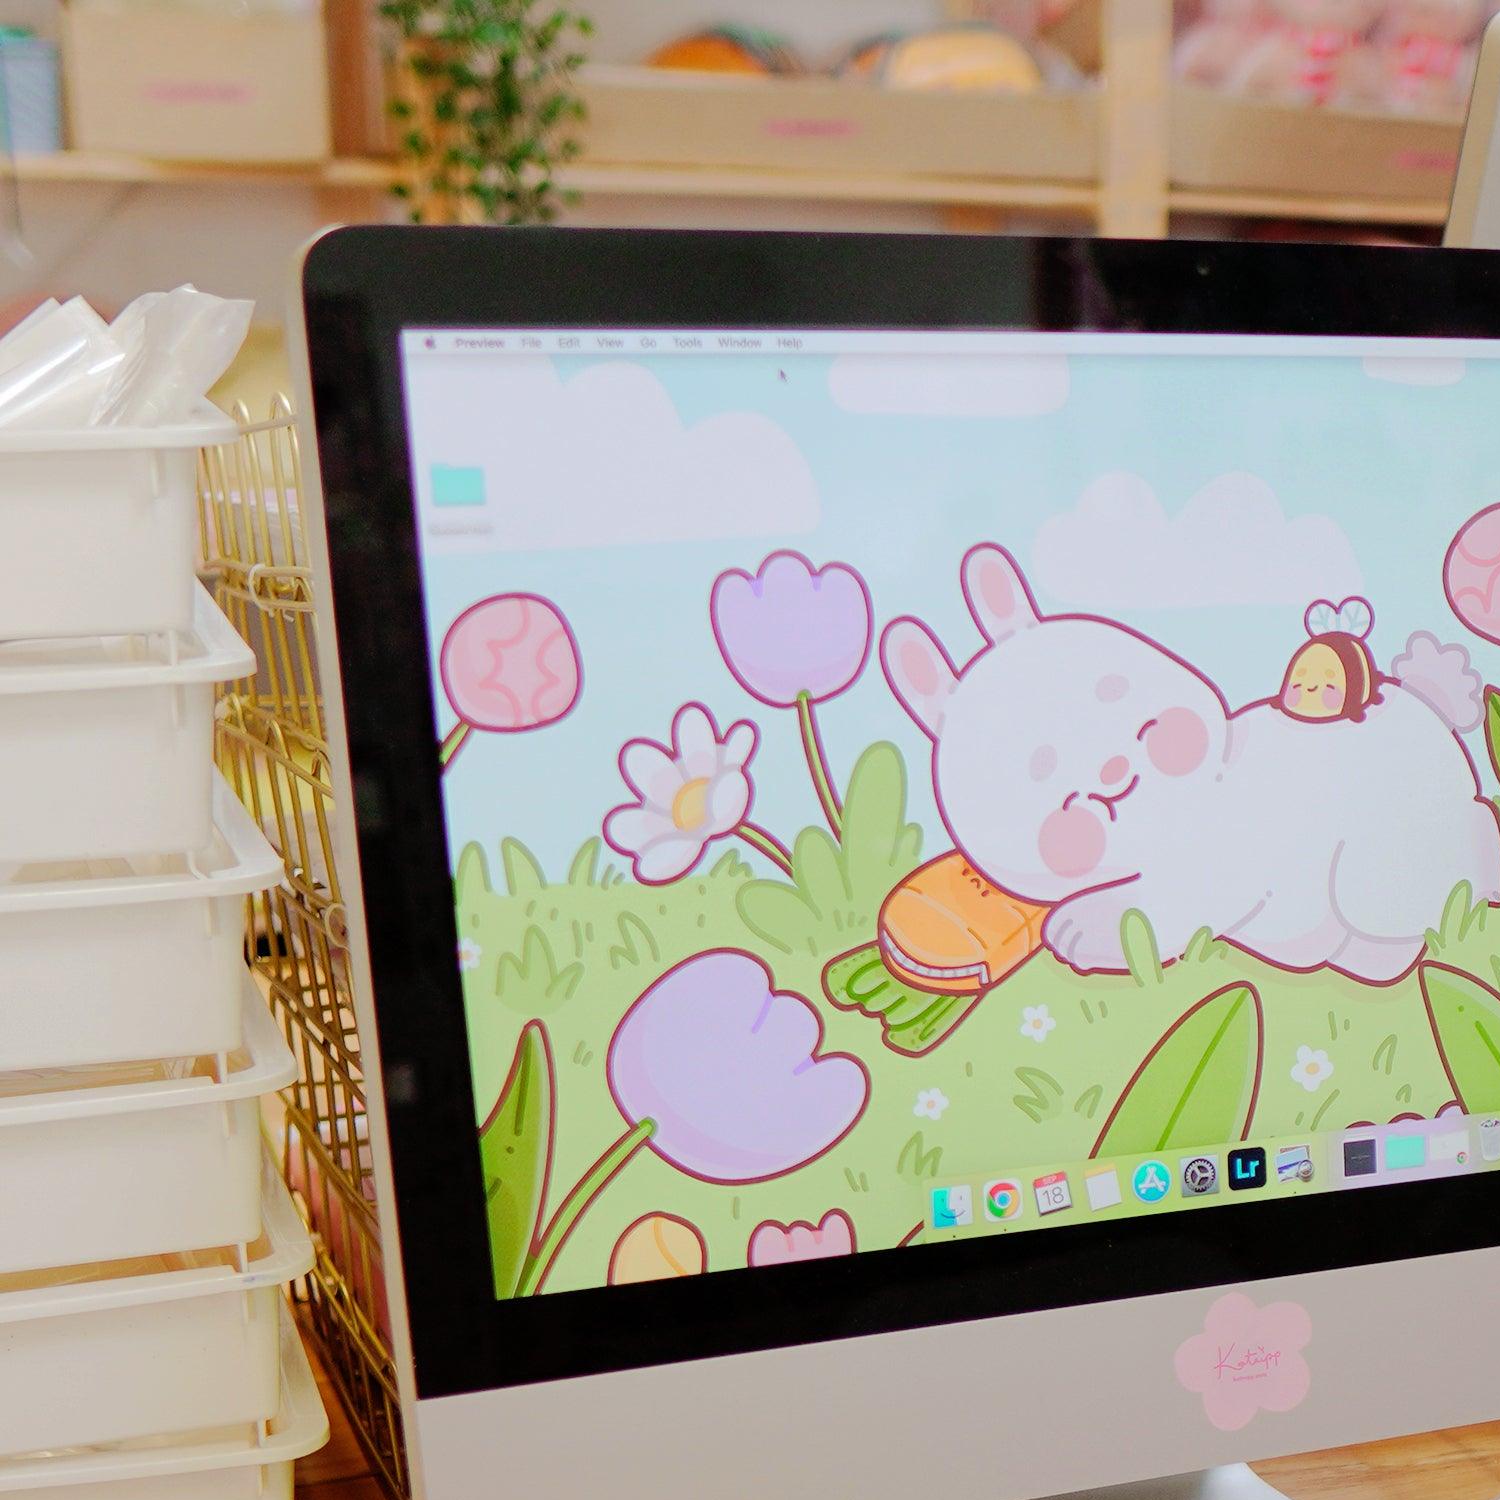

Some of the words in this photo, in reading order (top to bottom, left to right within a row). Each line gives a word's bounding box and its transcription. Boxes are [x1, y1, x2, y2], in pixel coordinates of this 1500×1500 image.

[455, 338, 505, 349] Preview
[521, 338, 542, 349] File
[558, 338, 580, 349] Edit
[597, 338, 625, 349] View
[673, 338, 702, 349] Tools
[718, 338, 761, 349] Window
[778, 338, 803, 350] Help
[1236, 1158, 1260, 1179] Lr
[1042, 1186, 1064, 1206] 18
